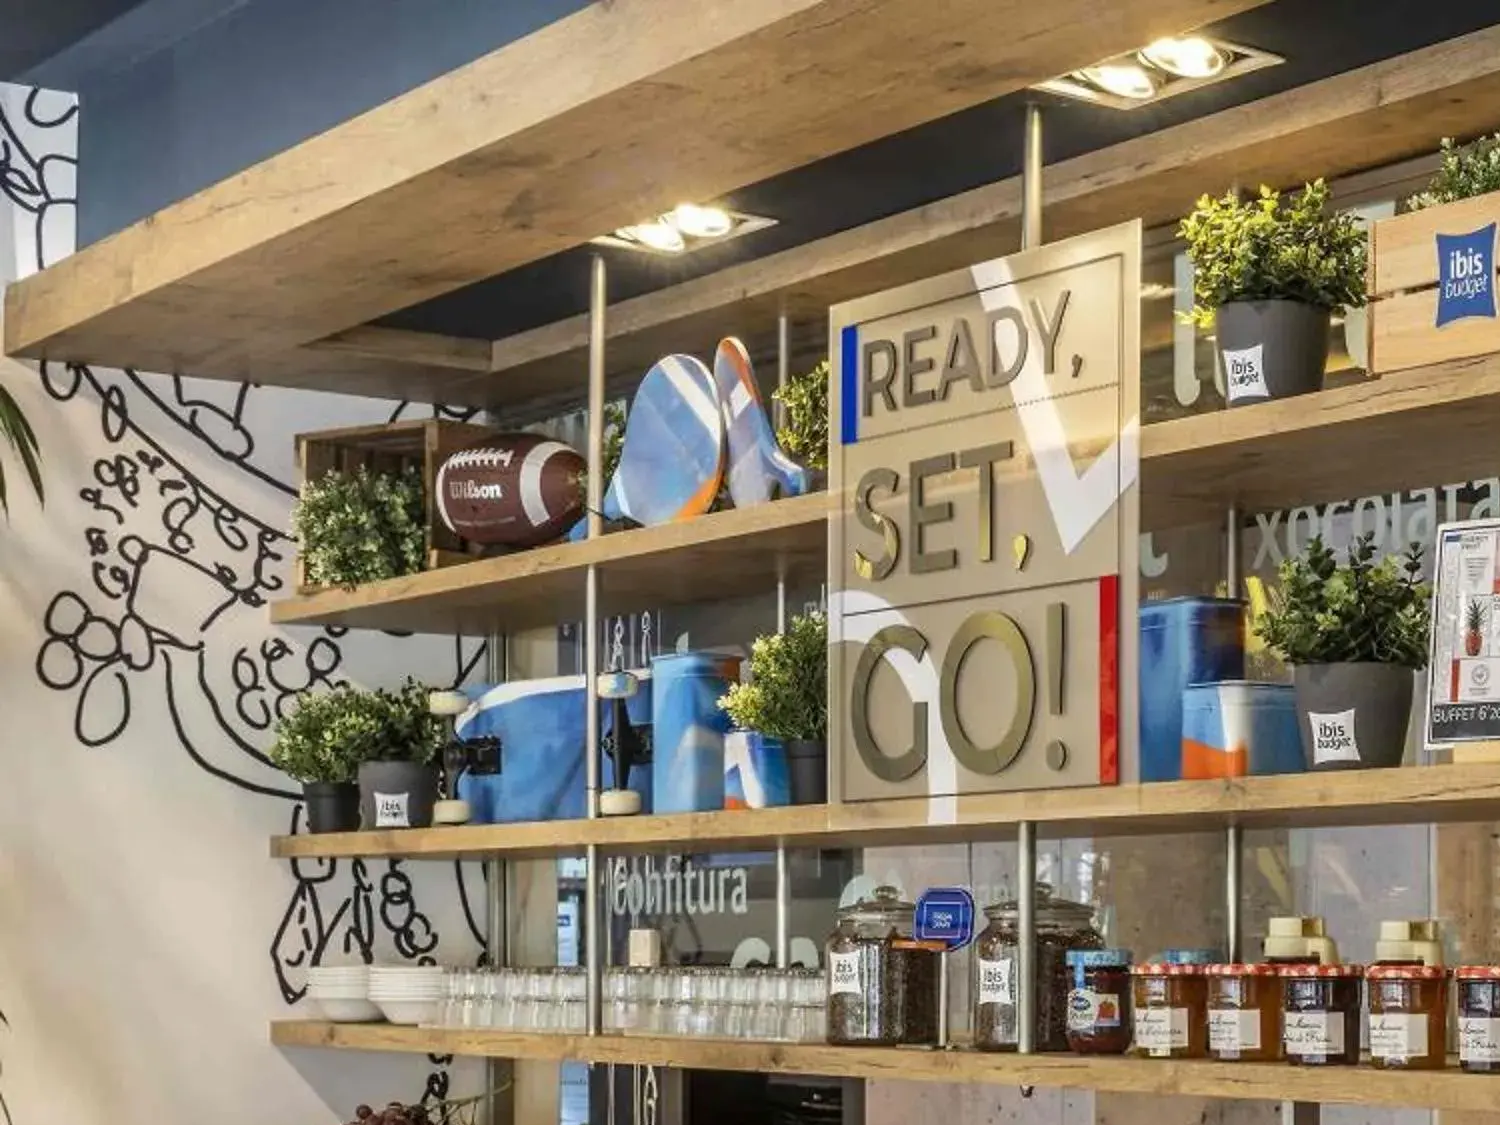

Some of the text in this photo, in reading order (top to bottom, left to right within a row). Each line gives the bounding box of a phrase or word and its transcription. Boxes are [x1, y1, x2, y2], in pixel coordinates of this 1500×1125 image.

[1451, 247, 1484, 279] ibis
[1446, 273, 1489, 299] budget
[862, 289, 1084, 418] READY,
[1231, 359, 1255, 376] ibis
[1230, 373, 1259, 387] budget
[449, 479, 503, 501] Wilson
[854, 441, 1032, 581] SET,
[851, 602, 1067, 783] GO!
[1432, 707, 1477, 724] BUFFET
[1319, 721, 1345, 738] ibis
[1317, 737, 1351, 751] budget
